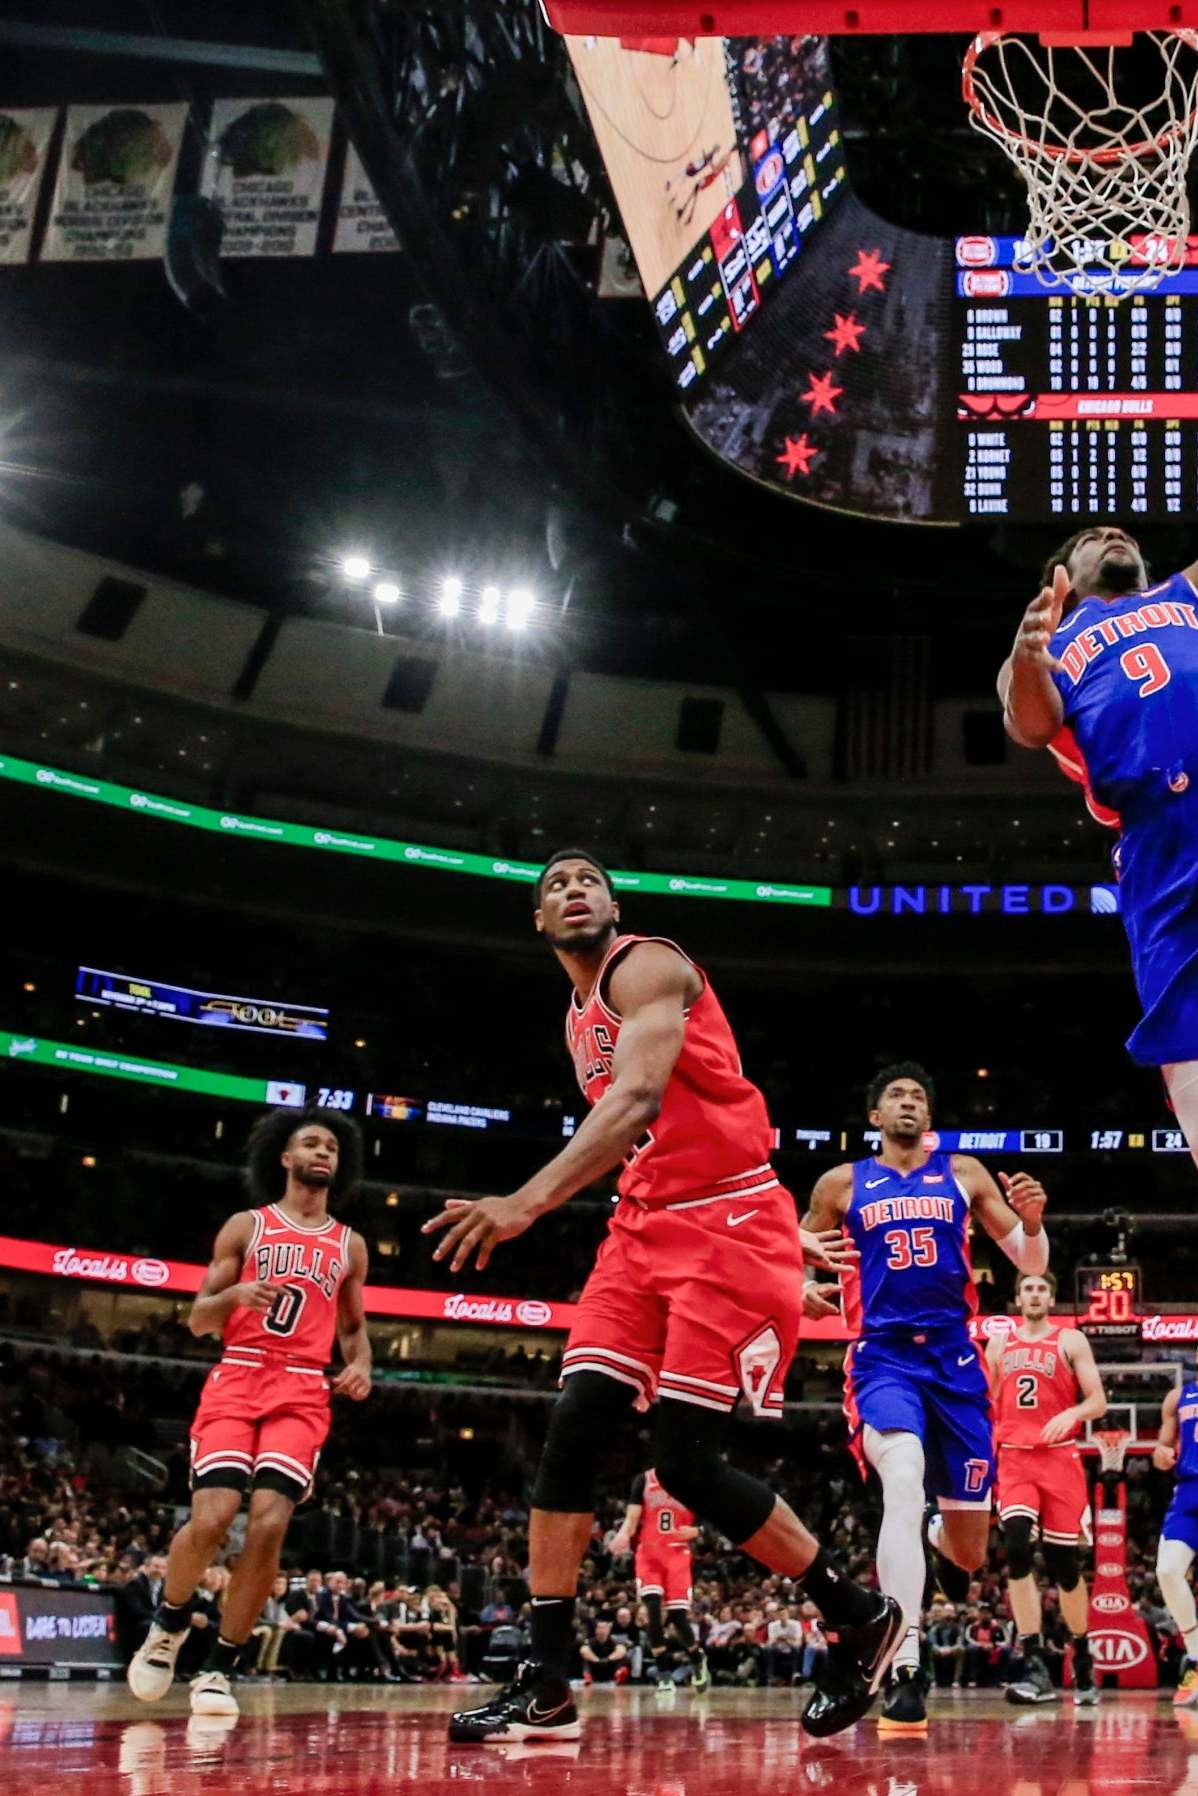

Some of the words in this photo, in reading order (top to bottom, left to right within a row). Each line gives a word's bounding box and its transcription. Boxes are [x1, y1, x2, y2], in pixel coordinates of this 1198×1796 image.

[1120, 643, 1171, 698] 9
[850, 886, 1075, 914] UNITED
[958, 1132, 1007, 1149] DETROIT
[1091, 1131, 1123, 1149] 1:57
[1165, 1132, 1182, 1148] 24
[859, 1196, 954, 1231] DETROIT
[885, 1227, 937, 1270] 35
[256, 1243, 342, 1300] BULLS
[262, 1283, 307, 1337] 0
[1089, 1290, 1130, 1321] 20
[1097, 1325, 1138, 1334] TISSOT
[1016, 1375, 1039, 1409] 2
[657, 1509, 674, 1534] 8
[1098, 1598, 1124, 1609] KIA
[1088, 1639, 1136, 1661] KIA
